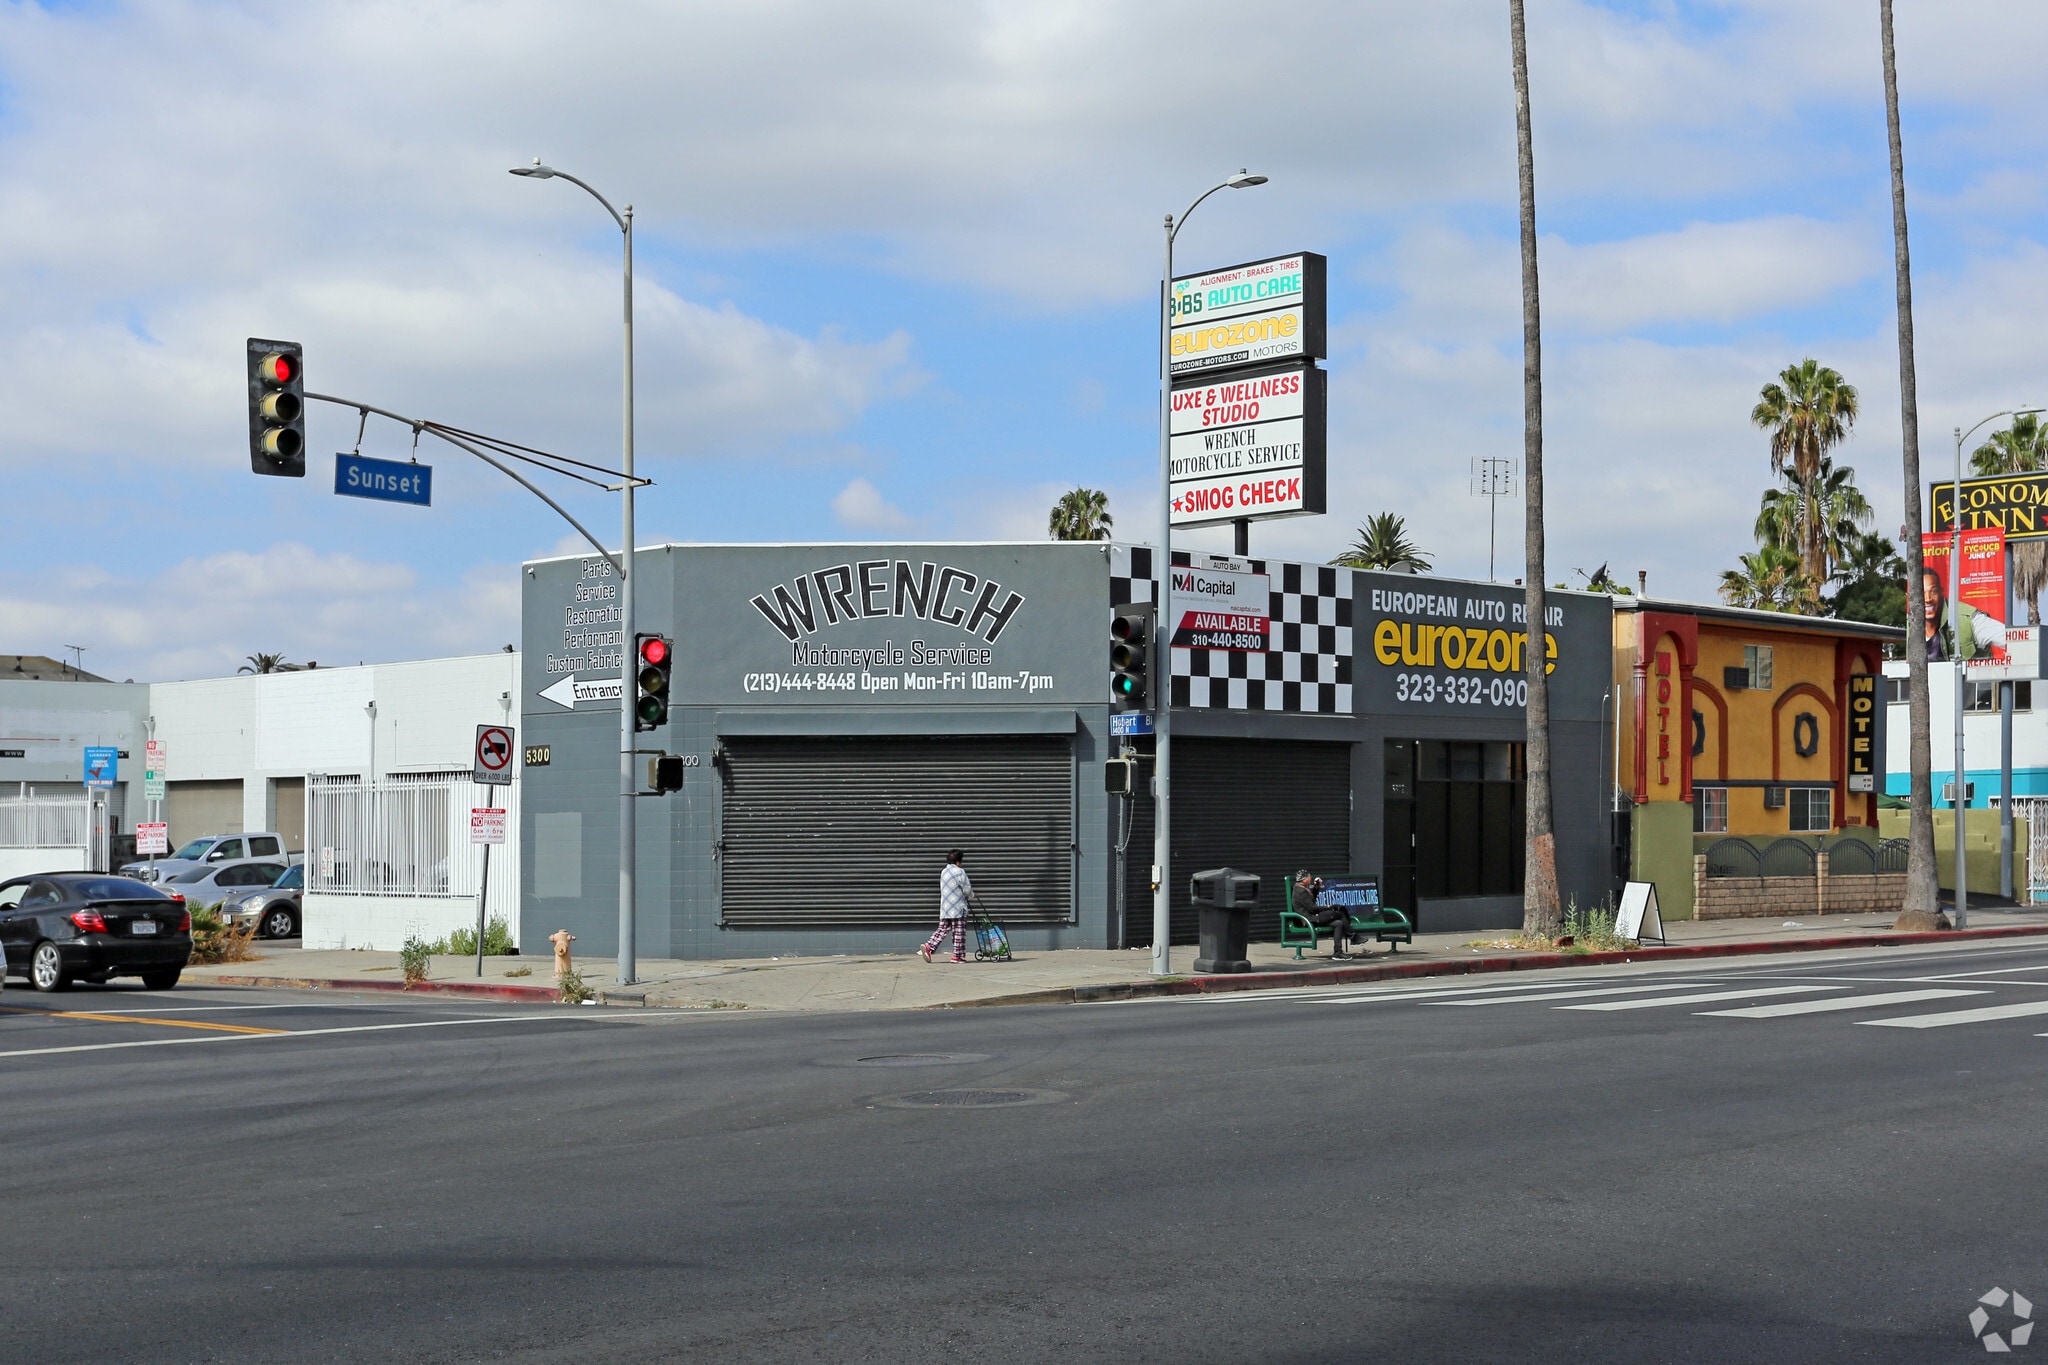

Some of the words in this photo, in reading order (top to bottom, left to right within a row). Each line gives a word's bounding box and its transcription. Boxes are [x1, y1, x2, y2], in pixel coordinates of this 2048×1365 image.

[1200, 272, 1241, 287] ALIGNMENT
[1247, 265, 1274, 278] BRAKES
[1280, 260, 1299, 270] TIRES
[1207, 283, 1252, 307] AUTO
[1257, 273, 1302, 297] CARE
[1171, 314, 1298, 356] eurozone
[1254, 342, 1298, 357] MOTORS
[1170, 352, 1248, 372] EUROZONE-MOTORS.COM
[1170, 391, 1202, 412] UXE
[1206, 388, 1216, 406] &
[1221, 375, 1299, 404] WELLNESS
[1202, 402, 1260, 426] STUDIO
[1205, 428, 1256, 450] WRENCH
[1248, 443, 1300, 465] SERVICE
[347, 466, 421, 495] Sunset
[1185, 486, 1233, 513] SMOG
[1240, 478, 1300, 506] CHECK
[1969, 506, 2037, 532] INN
[1922, 546, 1950, 556] arlon
[1968, 552, 1985, 560] JUNE
[582, 558, 612, 580] Parts
[1213, 562, 1228, 570] AUTO
[576, 582, 616, 602] Service
[1172, 572, 1194, 592] NAI
[1196, 578, 1235, 597] Capital
[749, 558, 1026, 646] WRENCH
[1372, 589, 1458, 618] EUROPEAN
[1464, 598, 1506, 623] AUTO
[1512, 603, 1564, 627] REAIR
[1194, 614, 1261, 632] AVAILABLE
[2006, 630, 2029, 640] HONE
[564, 628, 623, 649] Performan
[1192, 632, 1261, 649] 310-440-8500
[1374, 619, 1559, 675] eurozone
[546, 653, 584, 673] Custom
[586, 649, 623, 670] Fabric
[792, 640, 904, 672] Motorcycle
[910, 640, 992, 666] Service
[743, 672, 856, 693] (213)444-8448
[861, 672, 898, 694] Open
[904, 672, 966, 691] Mon-Fri
[971, 670, 1054, 694] 10am-7pm
[1396, 673, 1527, 707] 323-332-090
[1112, 716, 1136, 726] Hobart
[1656, 651, 1671, 785] MOTEL
[1853, 677, 1873, 772] MOTEL
[526, 748, 550, 763] 5300
[502, 773, 510, 781] LBS
[472, 818, 483, 826] NO
